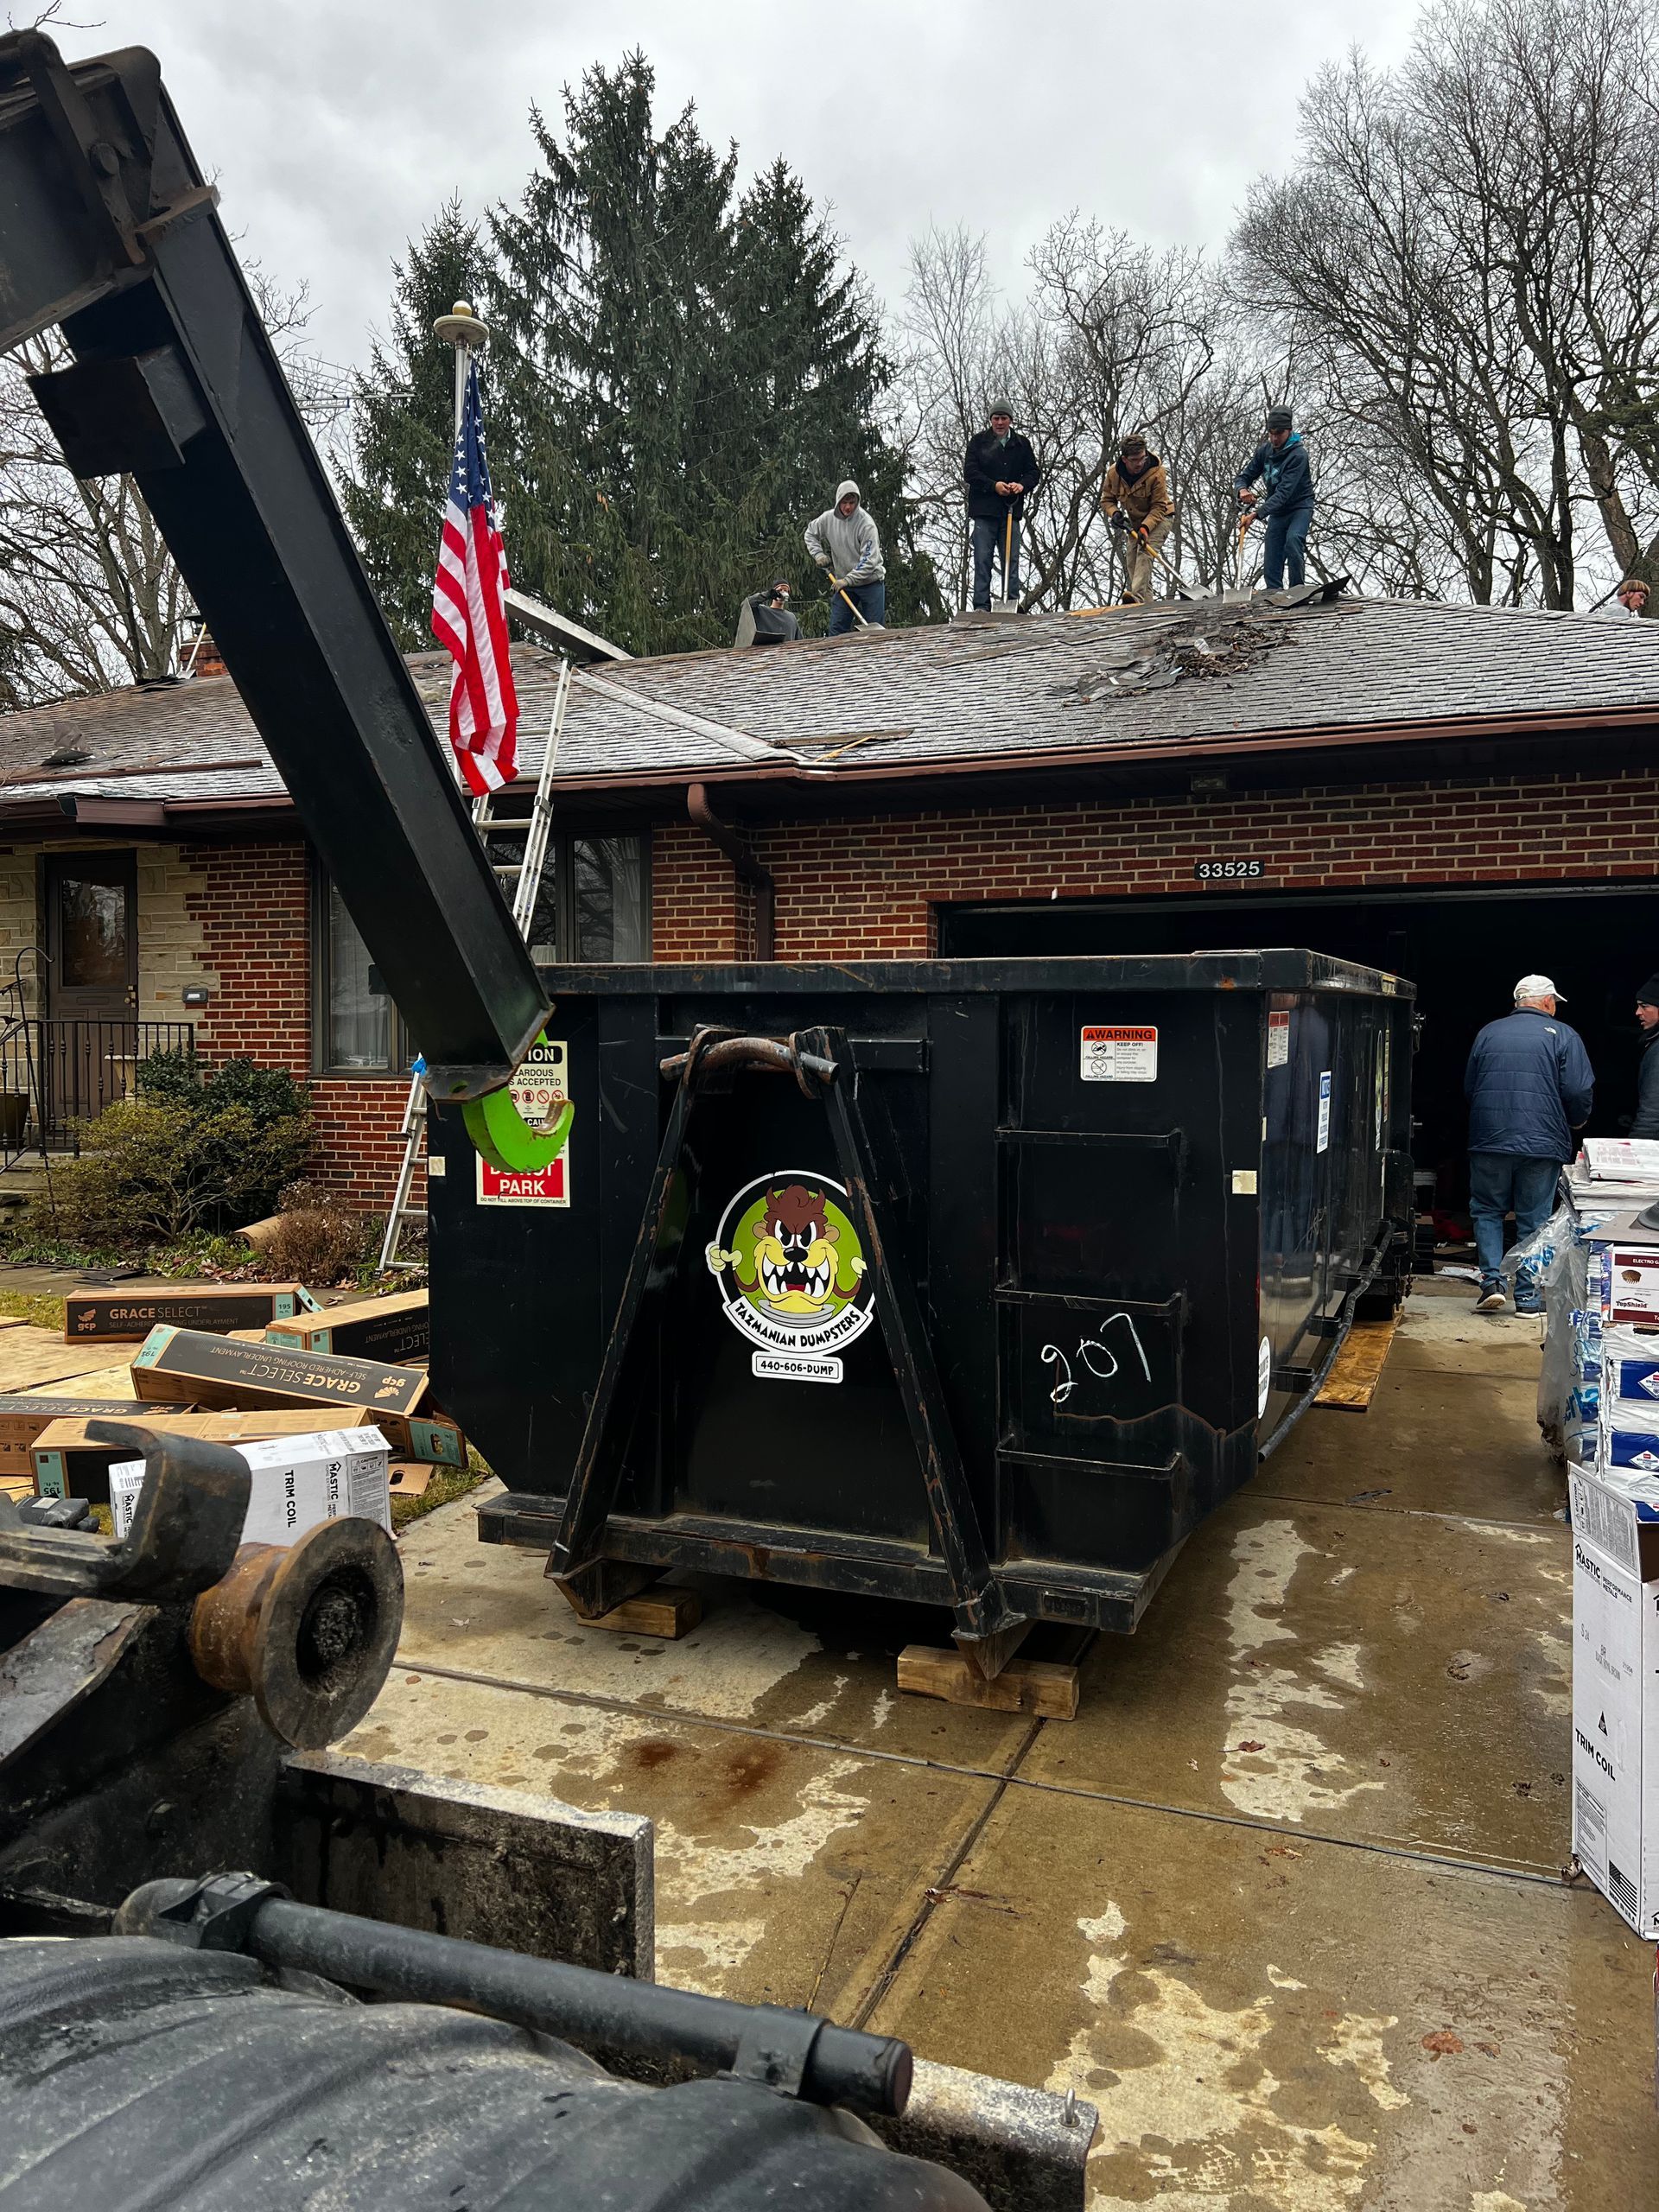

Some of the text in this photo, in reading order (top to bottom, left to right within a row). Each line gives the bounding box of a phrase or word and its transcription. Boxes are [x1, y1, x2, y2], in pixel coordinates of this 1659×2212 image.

[1199, 861, 1260, 878] 33525
[1095, 1030, 1153, 1039] WARNING
[499, 1179, 545, 1195] PARK
[110, 1308, 156, 1319] GRACE
[188, 1318, 238, 1326] UNDERLAYMENT
[78, 1322, 96, 1331] gcp
[735, 1302, 861, 1346] TAZMANIAN DUMPSTERS
[365, 1325, 410, 1344] UNDERLAYMENT
[209, 1347, 272, 1363] UNDERLAYMENT
[273, 1357, 307, 1370] ROOFING
[309, 1363, 367, 1380] SELF-ADHERED
[760, 1360, 834, 1376] 440-606-DUMP
[302, 1373, 361, 1394] GRACE
[382, 1376, 407, 1387] gcp
[329, 1462, 340, 1500] MASTIC
[284, 1470, 296, 1529] TRIM COIL
[124, 1494, 133, 1523] MASTIC
[1575, 1545, 1601, 1579] MASTIC
[1575, 1728, 1616, 1781] TRIM COIL
